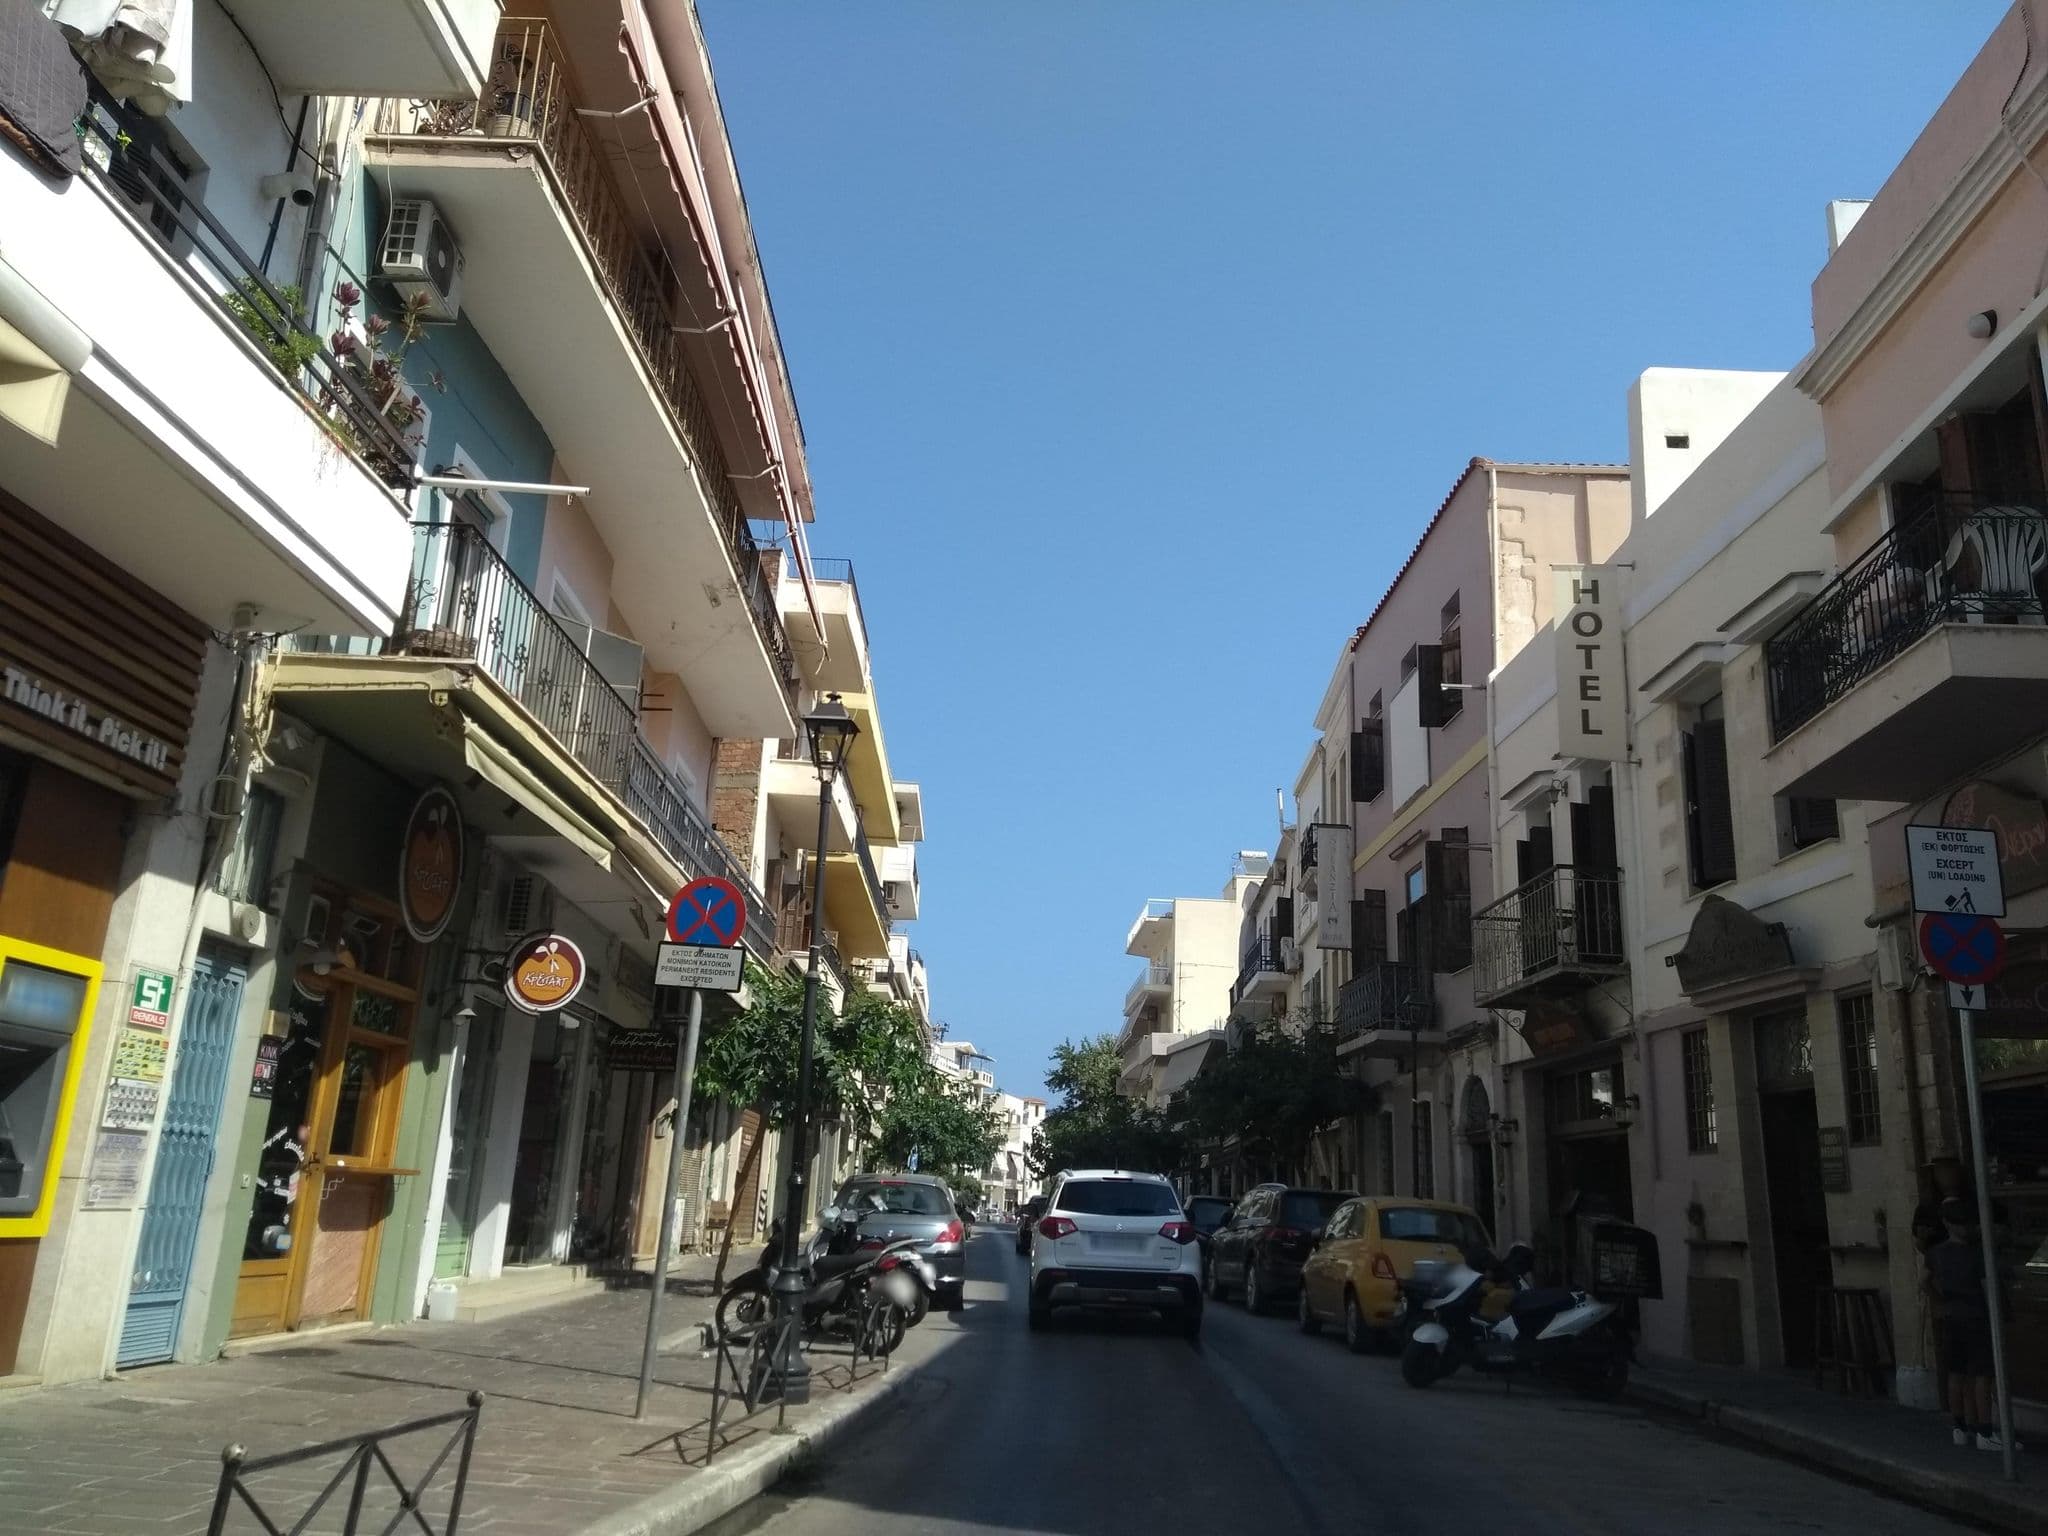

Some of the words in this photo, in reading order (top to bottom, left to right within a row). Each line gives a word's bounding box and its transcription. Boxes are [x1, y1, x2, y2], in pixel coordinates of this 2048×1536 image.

[1571, 579, 1604, 736] HOTEL
[5, 667, 66, 723] Think
[99, 717, 142, 761] Pick
[1936, 831, 1968, 842] ΕΚΤΟΣ
[1941, 844, 1985, 854] ΦΟΡΤΩΣΗΣ
[1936, 859, 1974, 870] EXCEPT
[1948, 872, 1986, 882] LOADING
[671, 949, 692, 958] ΕΚΤΟΣ
[660, 966, 699, 974] PERMANENT
[700, 969, 736, 977] RESIDENTS
[680, 975, 713, 983] EXCEPTED
[132, 1011, 166, 1026] RENTALS
